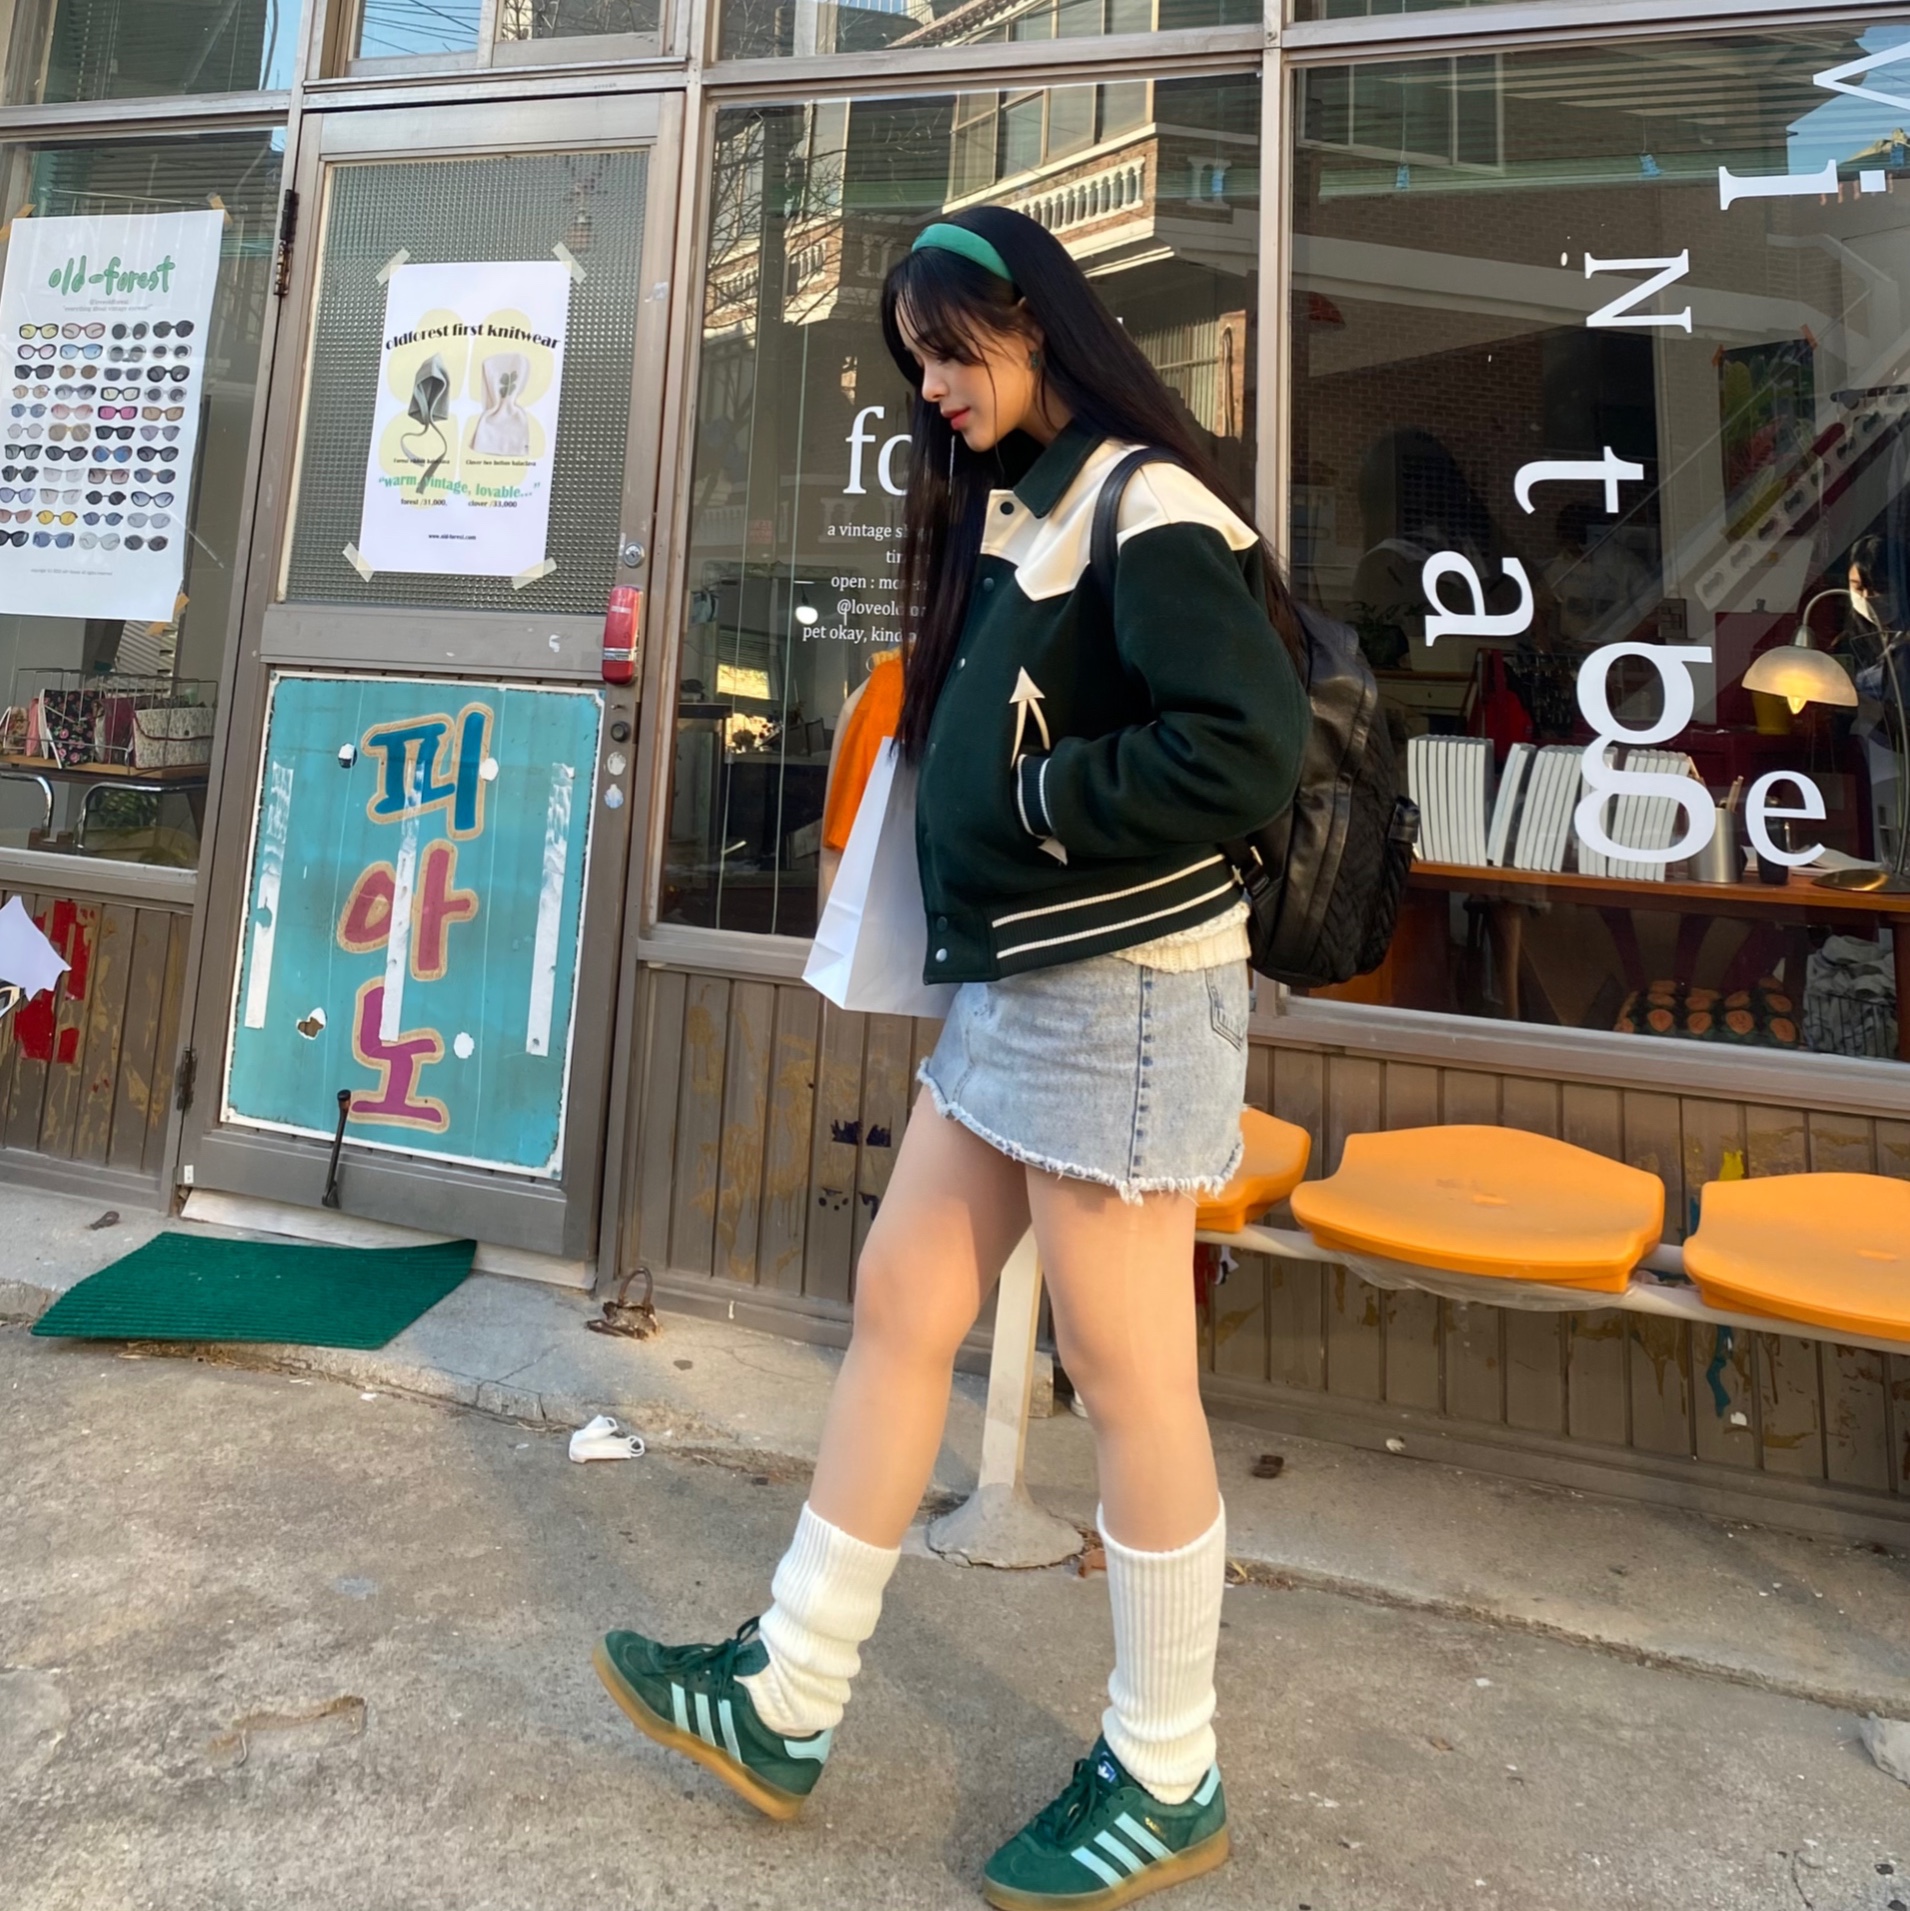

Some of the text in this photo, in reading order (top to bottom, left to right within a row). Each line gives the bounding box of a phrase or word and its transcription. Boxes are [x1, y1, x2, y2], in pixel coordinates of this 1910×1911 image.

[48, 255, 176, 296] old-forest
[385, 323, 561, 350] oldforest first knitwear
[842, 406, 912, 496] fo
[827, 525, 836, 536] a
[839, 522, 892, 541] vintage
[831, 576, 867, 592] open
[803, 625, 827, 642] pet
[829, 624, 868, 644] okay,
[336, 702, 500, 1133] 피아노
